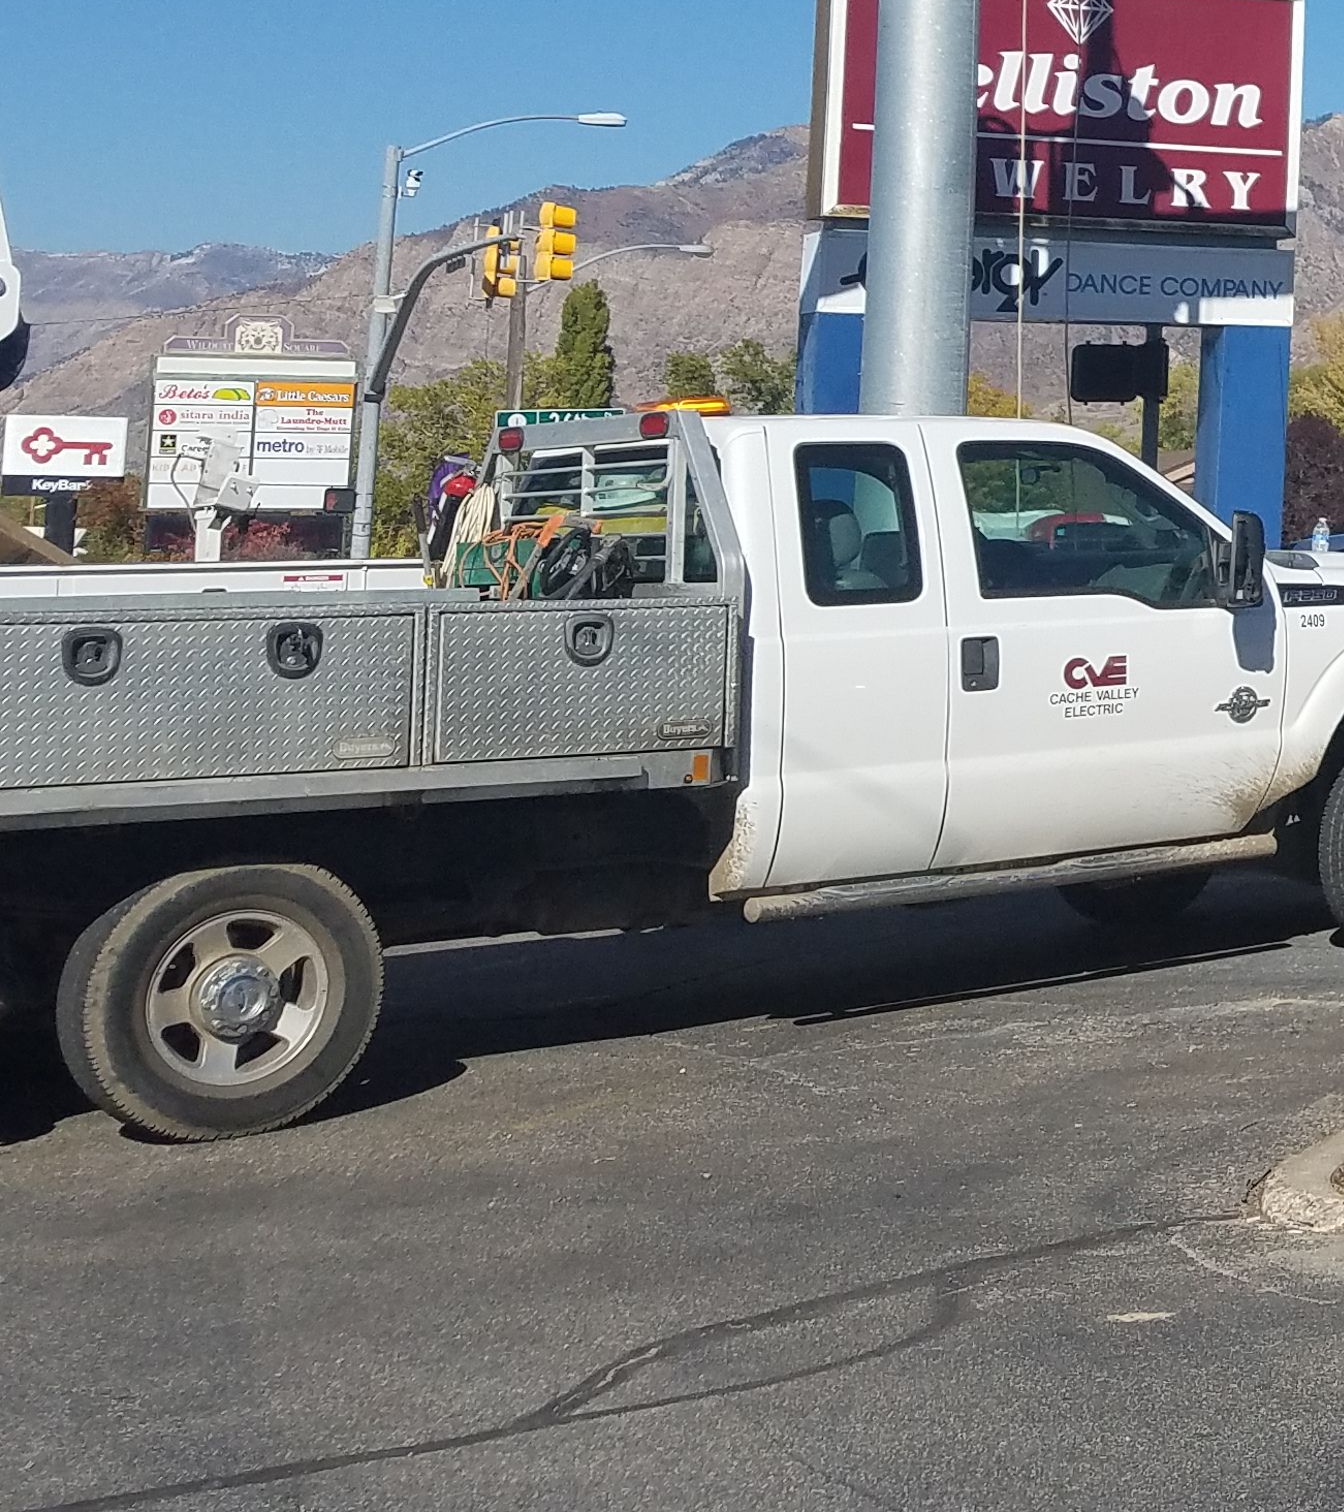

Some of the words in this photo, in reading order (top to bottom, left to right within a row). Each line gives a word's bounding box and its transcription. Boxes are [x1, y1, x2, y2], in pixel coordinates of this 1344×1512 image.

[977, 51, 1263, 129] elliston
[989, 158, 1261, 210] WELRY
[1067, 272, 1152, 296] DANCE
[1161, 275, 1285, 300] COMPANY
[159, 384, 210, 399] Beto's
[277, 390, 306, 402] Little
[307, 391, 350, 403] Caesars
[180, 409, 214, 420] sitara
[218, 410, 250, 420] india
[257, 439, 304, 453] metro
[1300, 614, 1325, 627] 2409
[1064, 656, 1127, 690] CVE
[1050, 692, 1092, 706] CACHE
[1096, 687, 1140, 702] VALLEY
[1064, 702, 1124, 719] ELECTRIC
